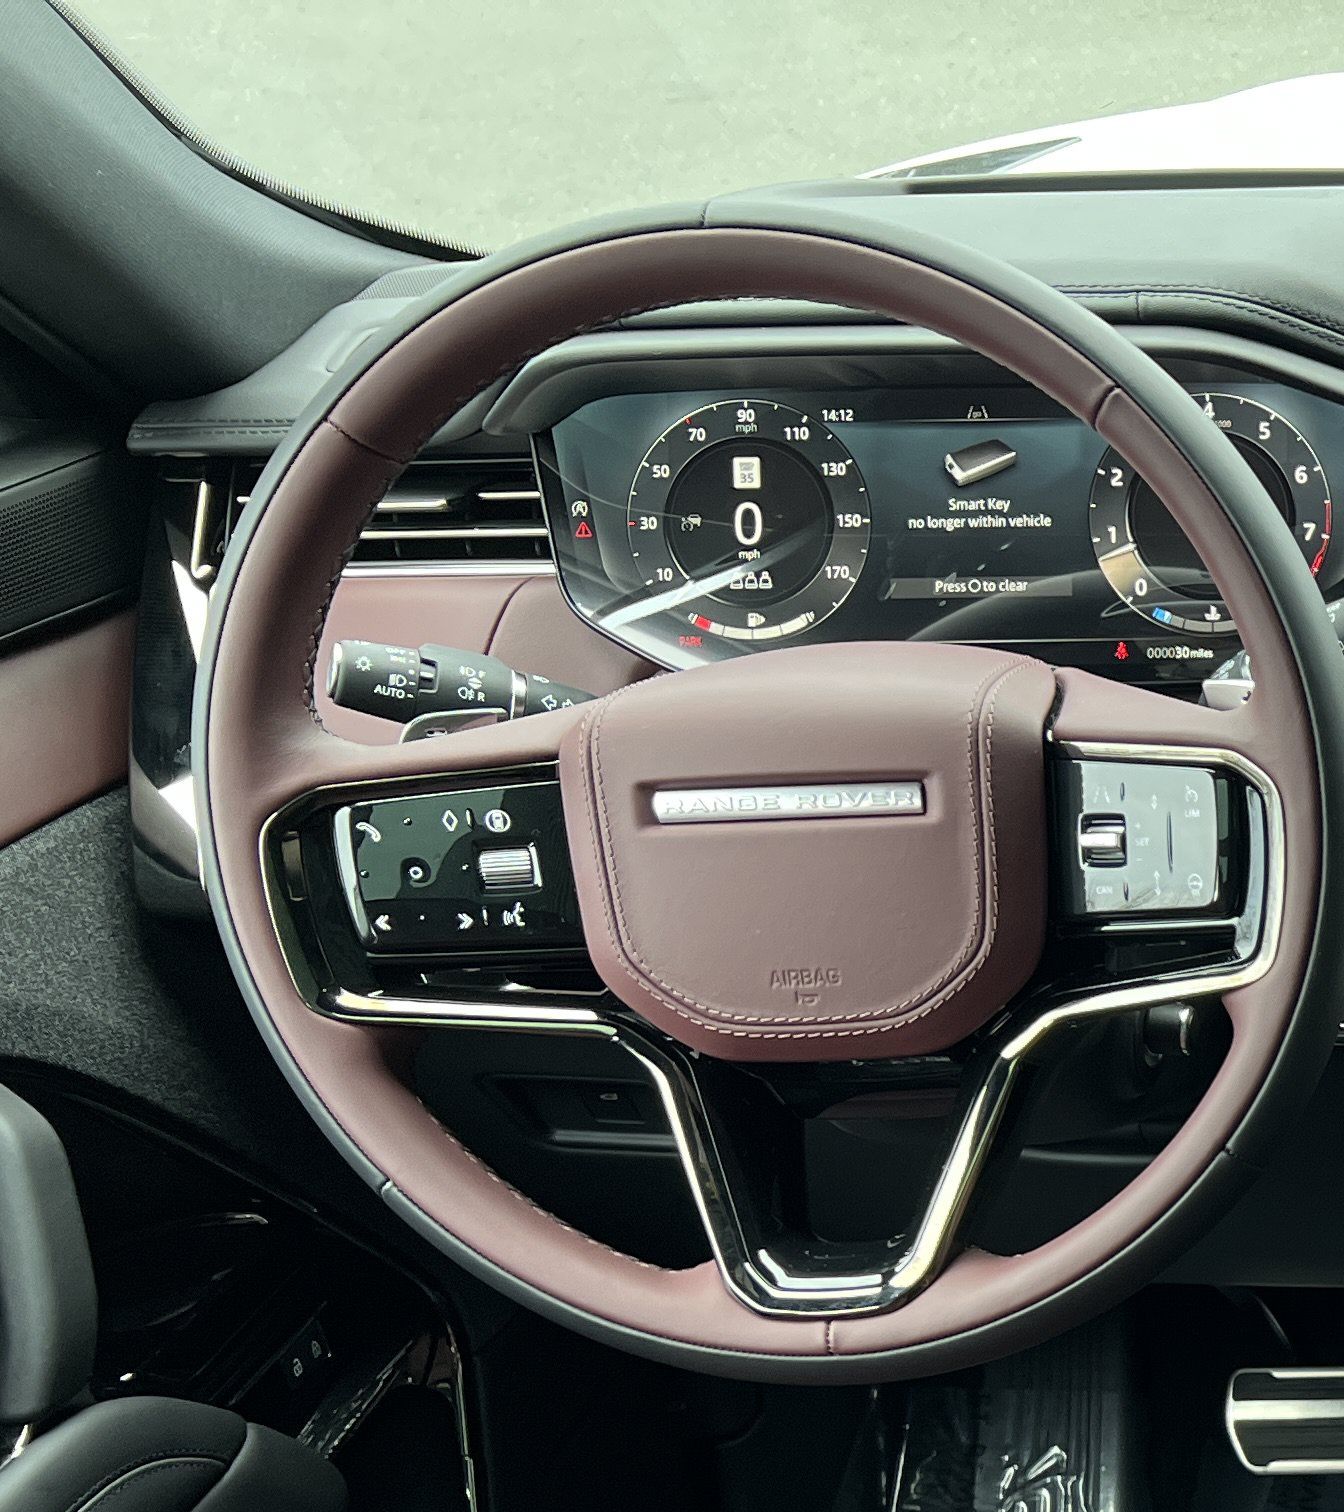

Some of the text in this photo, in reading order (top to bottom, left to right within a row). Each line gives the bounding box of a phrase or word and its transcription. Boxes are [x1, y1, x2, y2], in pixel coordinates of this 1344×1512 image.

[736, 409, 755, 422] 90
[821, 409, 854, 422] 14:12
[688, 428, 706, 441] 70
[735, 423, 758, 434] mph
[783, 427, 809, 440] 110
[1258, 422, 1271, 440] 5
[652, 465, 670, 478] 50
[821, 463, 846, 476] 130
[1294, 465, 1308, 484] 6
[739, 473, 754, 484] 35
[1110, 469, 1124, 487] 2
[948, 498, 1011, 513] Smart Key
[640, 517, 657, 530] 30
[734, 501, 763, 546] 0
[837, 514, 861, 527] 150
[908, 514, 1052, 531] no longer within vehicle
[1107, 526, 1117, 544] 1
[1302, 522, 1316, 541] 7
[738, 549, 761, 561] mph
[656, 568, 673, 581] 10
[825, 566, 850, 579] 170
[935, 580, 1029, 593] Press to clear
[1134, 578, 1148, 597] 0
[1189, 648, 1214, 660] miles
[373, 684, 406, 699] AUTO
[664, 789, 916, 815] RANGE ROVER
[769, 967, 842, 989] AIRBAG
